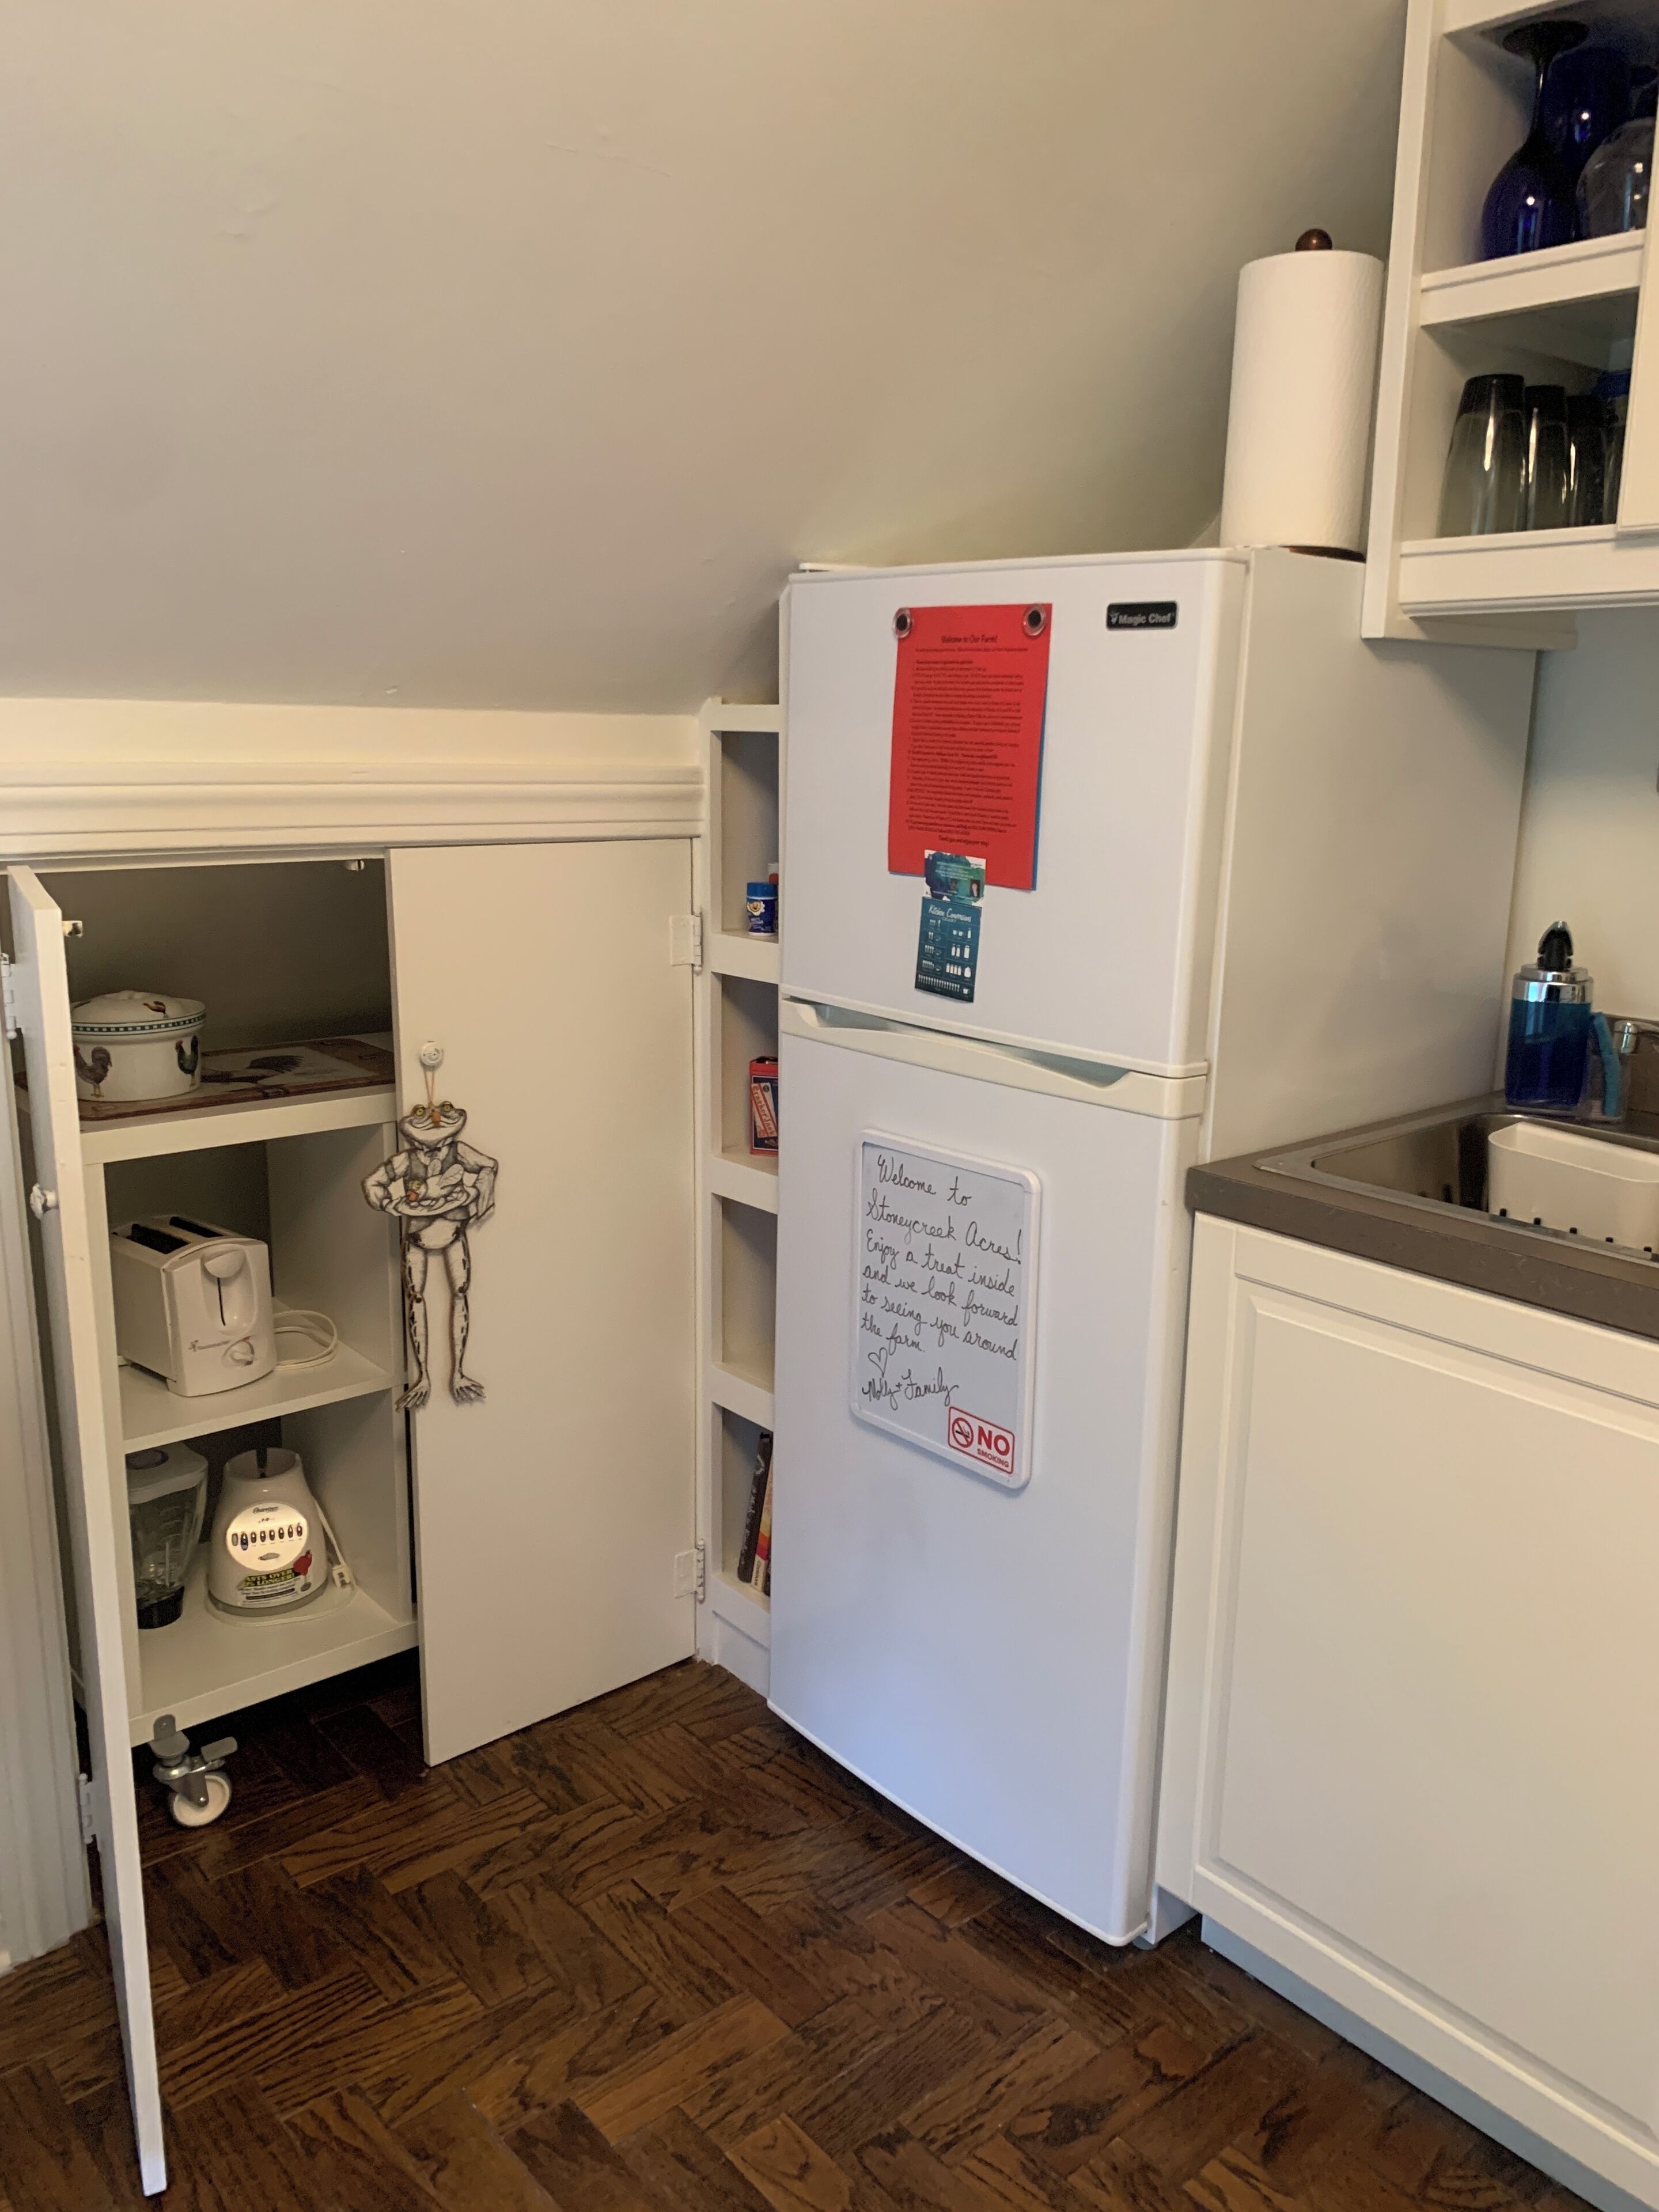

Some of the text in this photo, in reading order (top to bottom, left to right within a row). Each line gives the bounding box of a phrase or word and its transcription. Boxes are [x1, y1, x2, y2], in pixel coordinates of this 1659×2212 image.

[1119, 612, 1171, 626] Magic Chef
[929, 905, 945, 916] Kitchen
[877, 1154, 972, 1206] Welcome to
[866, 1188, 1021, 1264] Stoneycreek Acres!
[866, 1229, 1016, 1297] Enjoy a treat inside
[863, 1265, 1018, 1326] and we look forward
[860, 1312, 883, 1337] the
[861, 1283, 1017, 1361] to seeing you around
[902, 1366, 960, 1407] Family
[977, 1448, 1010, 1468] SMOKING
[978, 1425, 1010, 1456] NO
